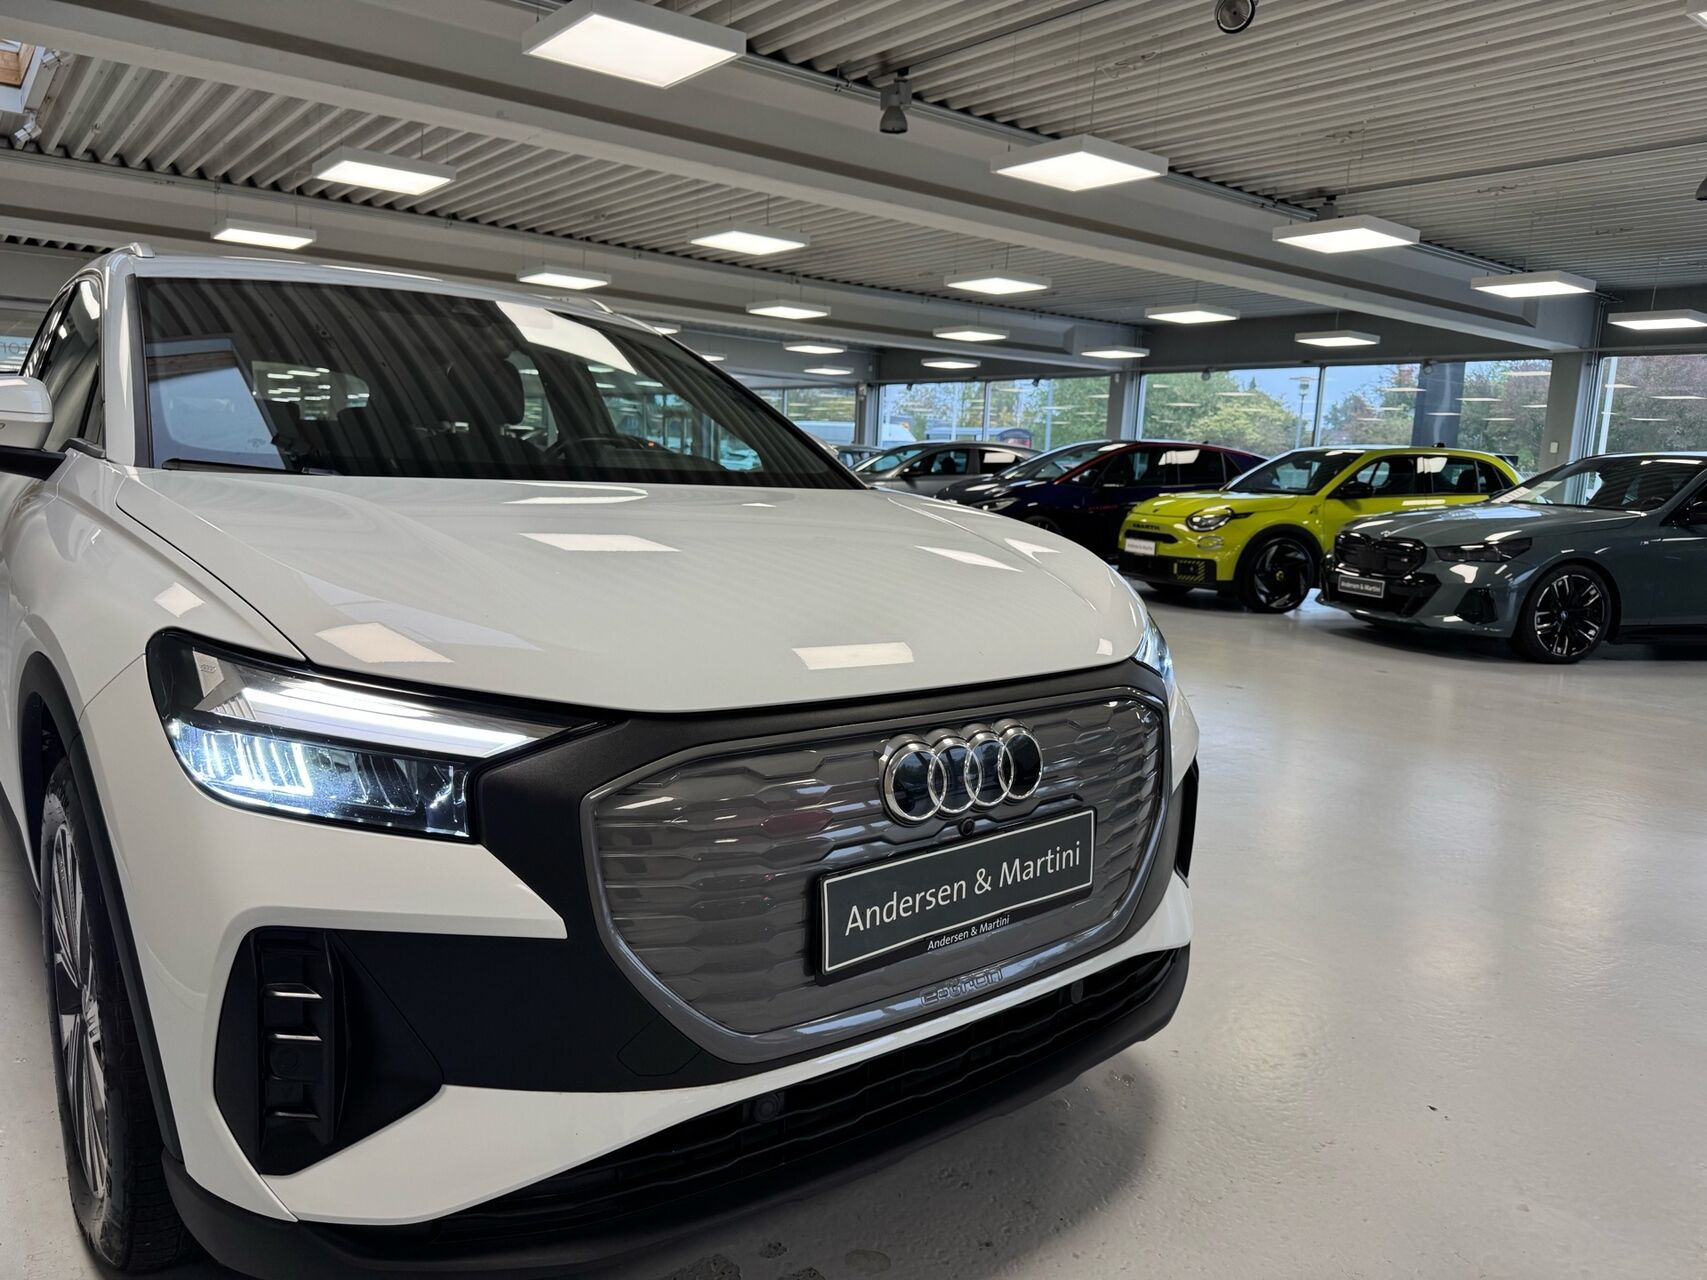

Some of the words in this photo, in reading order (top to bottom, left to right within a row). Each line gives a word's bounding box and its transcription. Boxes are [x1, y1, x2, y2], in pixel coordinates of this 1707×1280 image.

[845, 880, 967, 936] Andersen
[974, 867, 992, 894] &
[999, 840, 1080, 888] Martini
[927, 930, 969, 951] Andersen
[970, 926, 978, 937] &
[979, 914, 1010, 934] Martini
